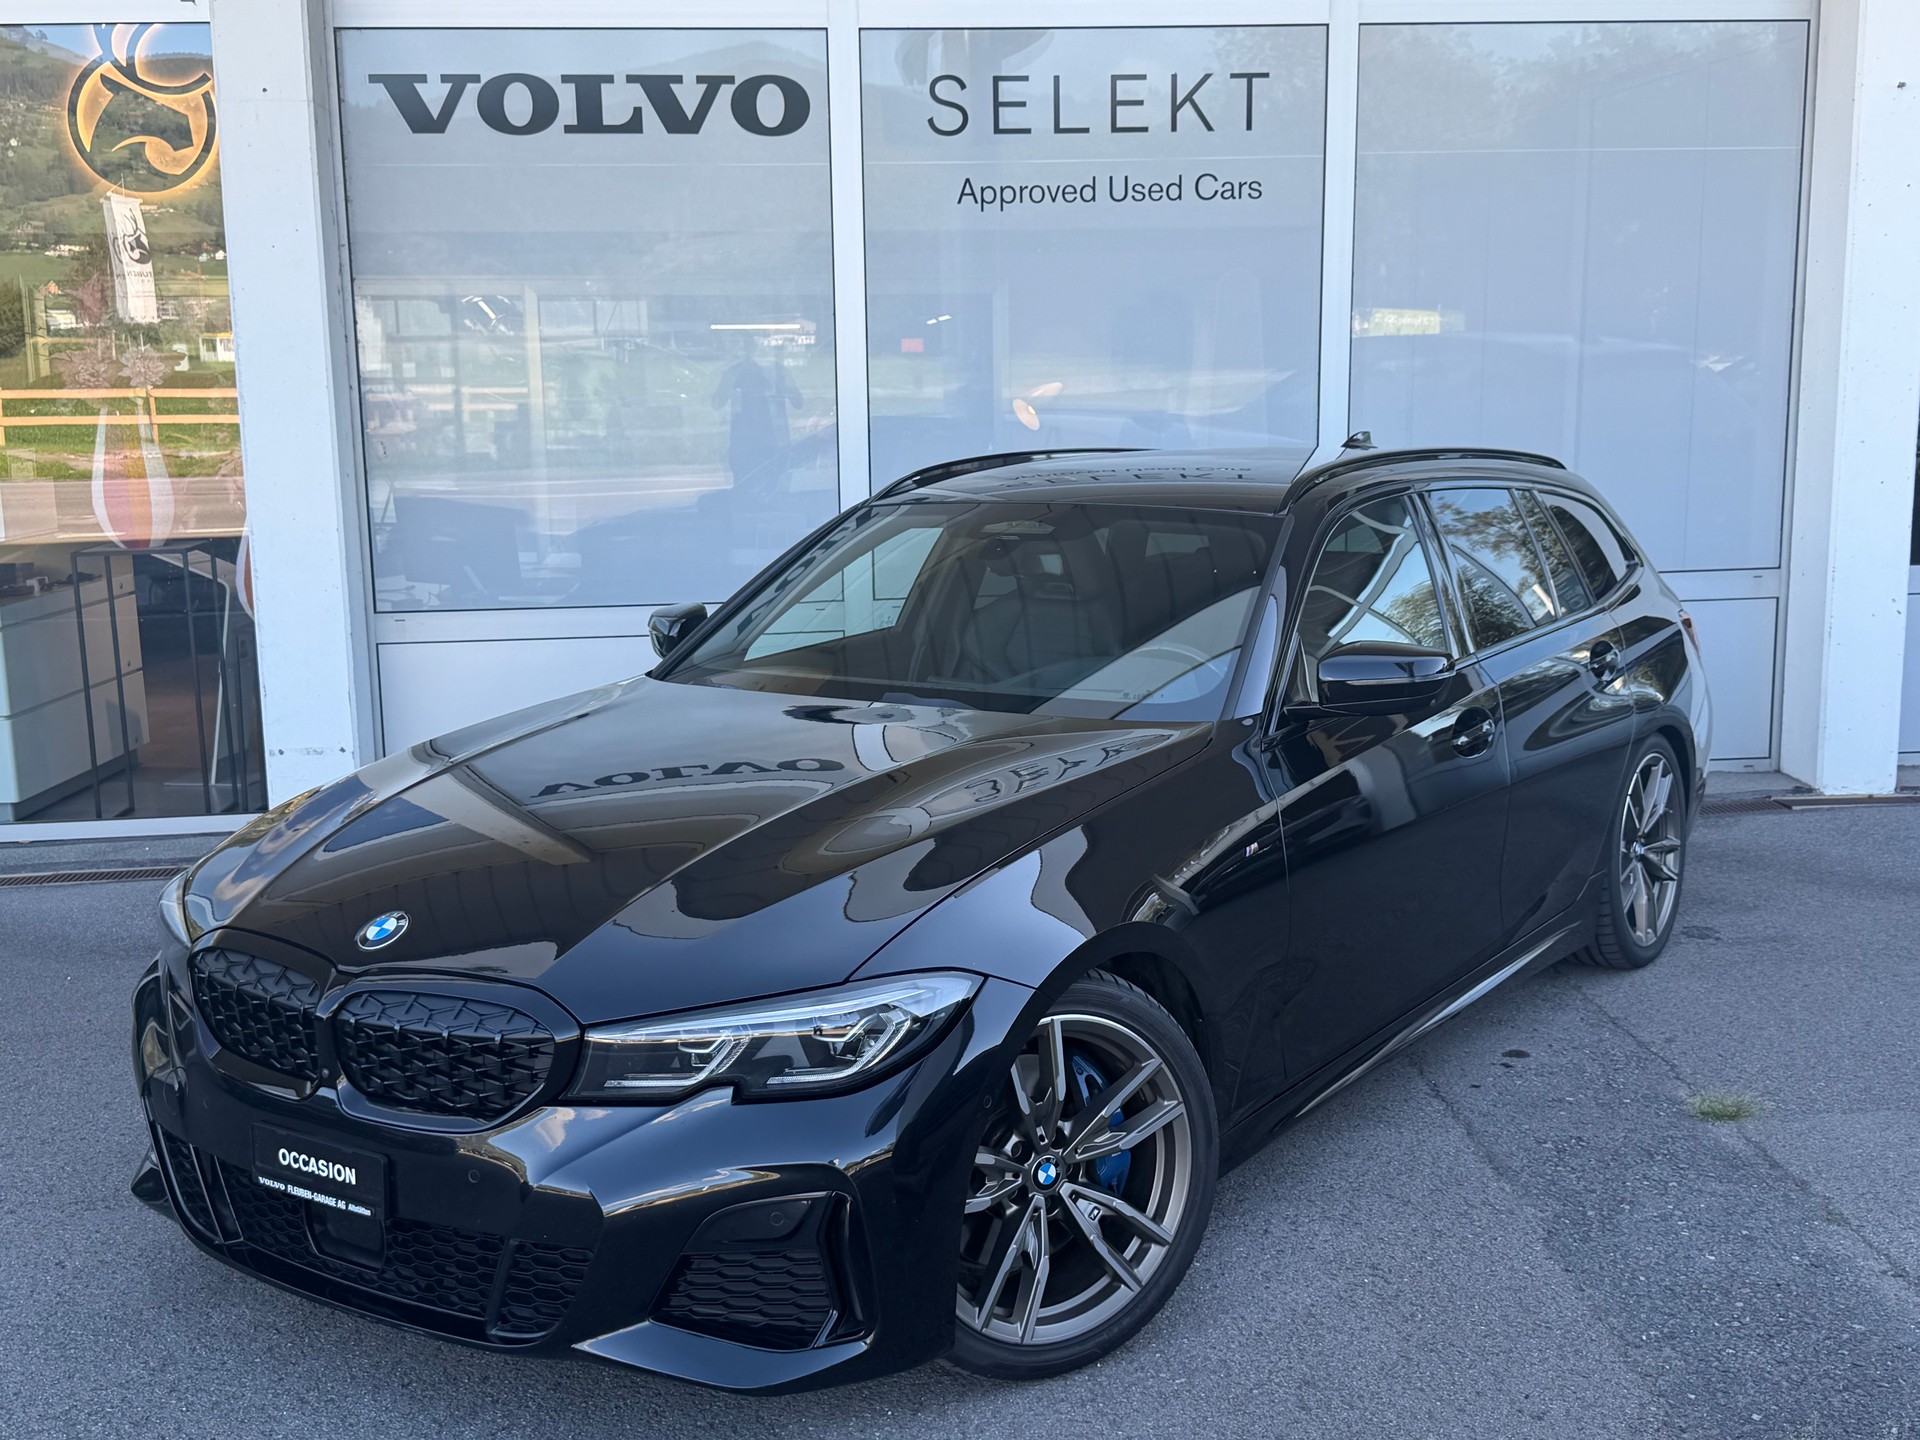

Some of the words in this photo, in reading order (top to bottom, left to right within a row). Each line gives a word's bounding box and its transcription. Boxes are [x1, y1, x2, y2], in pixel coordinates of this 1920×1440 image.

[368, 73, 810, 136] VOLVO
[927, 72, 1270, 136] SELEKT
[957, 176, 1097, 212] Approved
[1108, 174, 1183, 202] Used
[1194, 173, 1263, 201] Cars
[278, 1148, 356, 1185] OCCASION
[258, 1176, 286, 1190] VOLVO
[337, 1199, 346, 1210] AG
